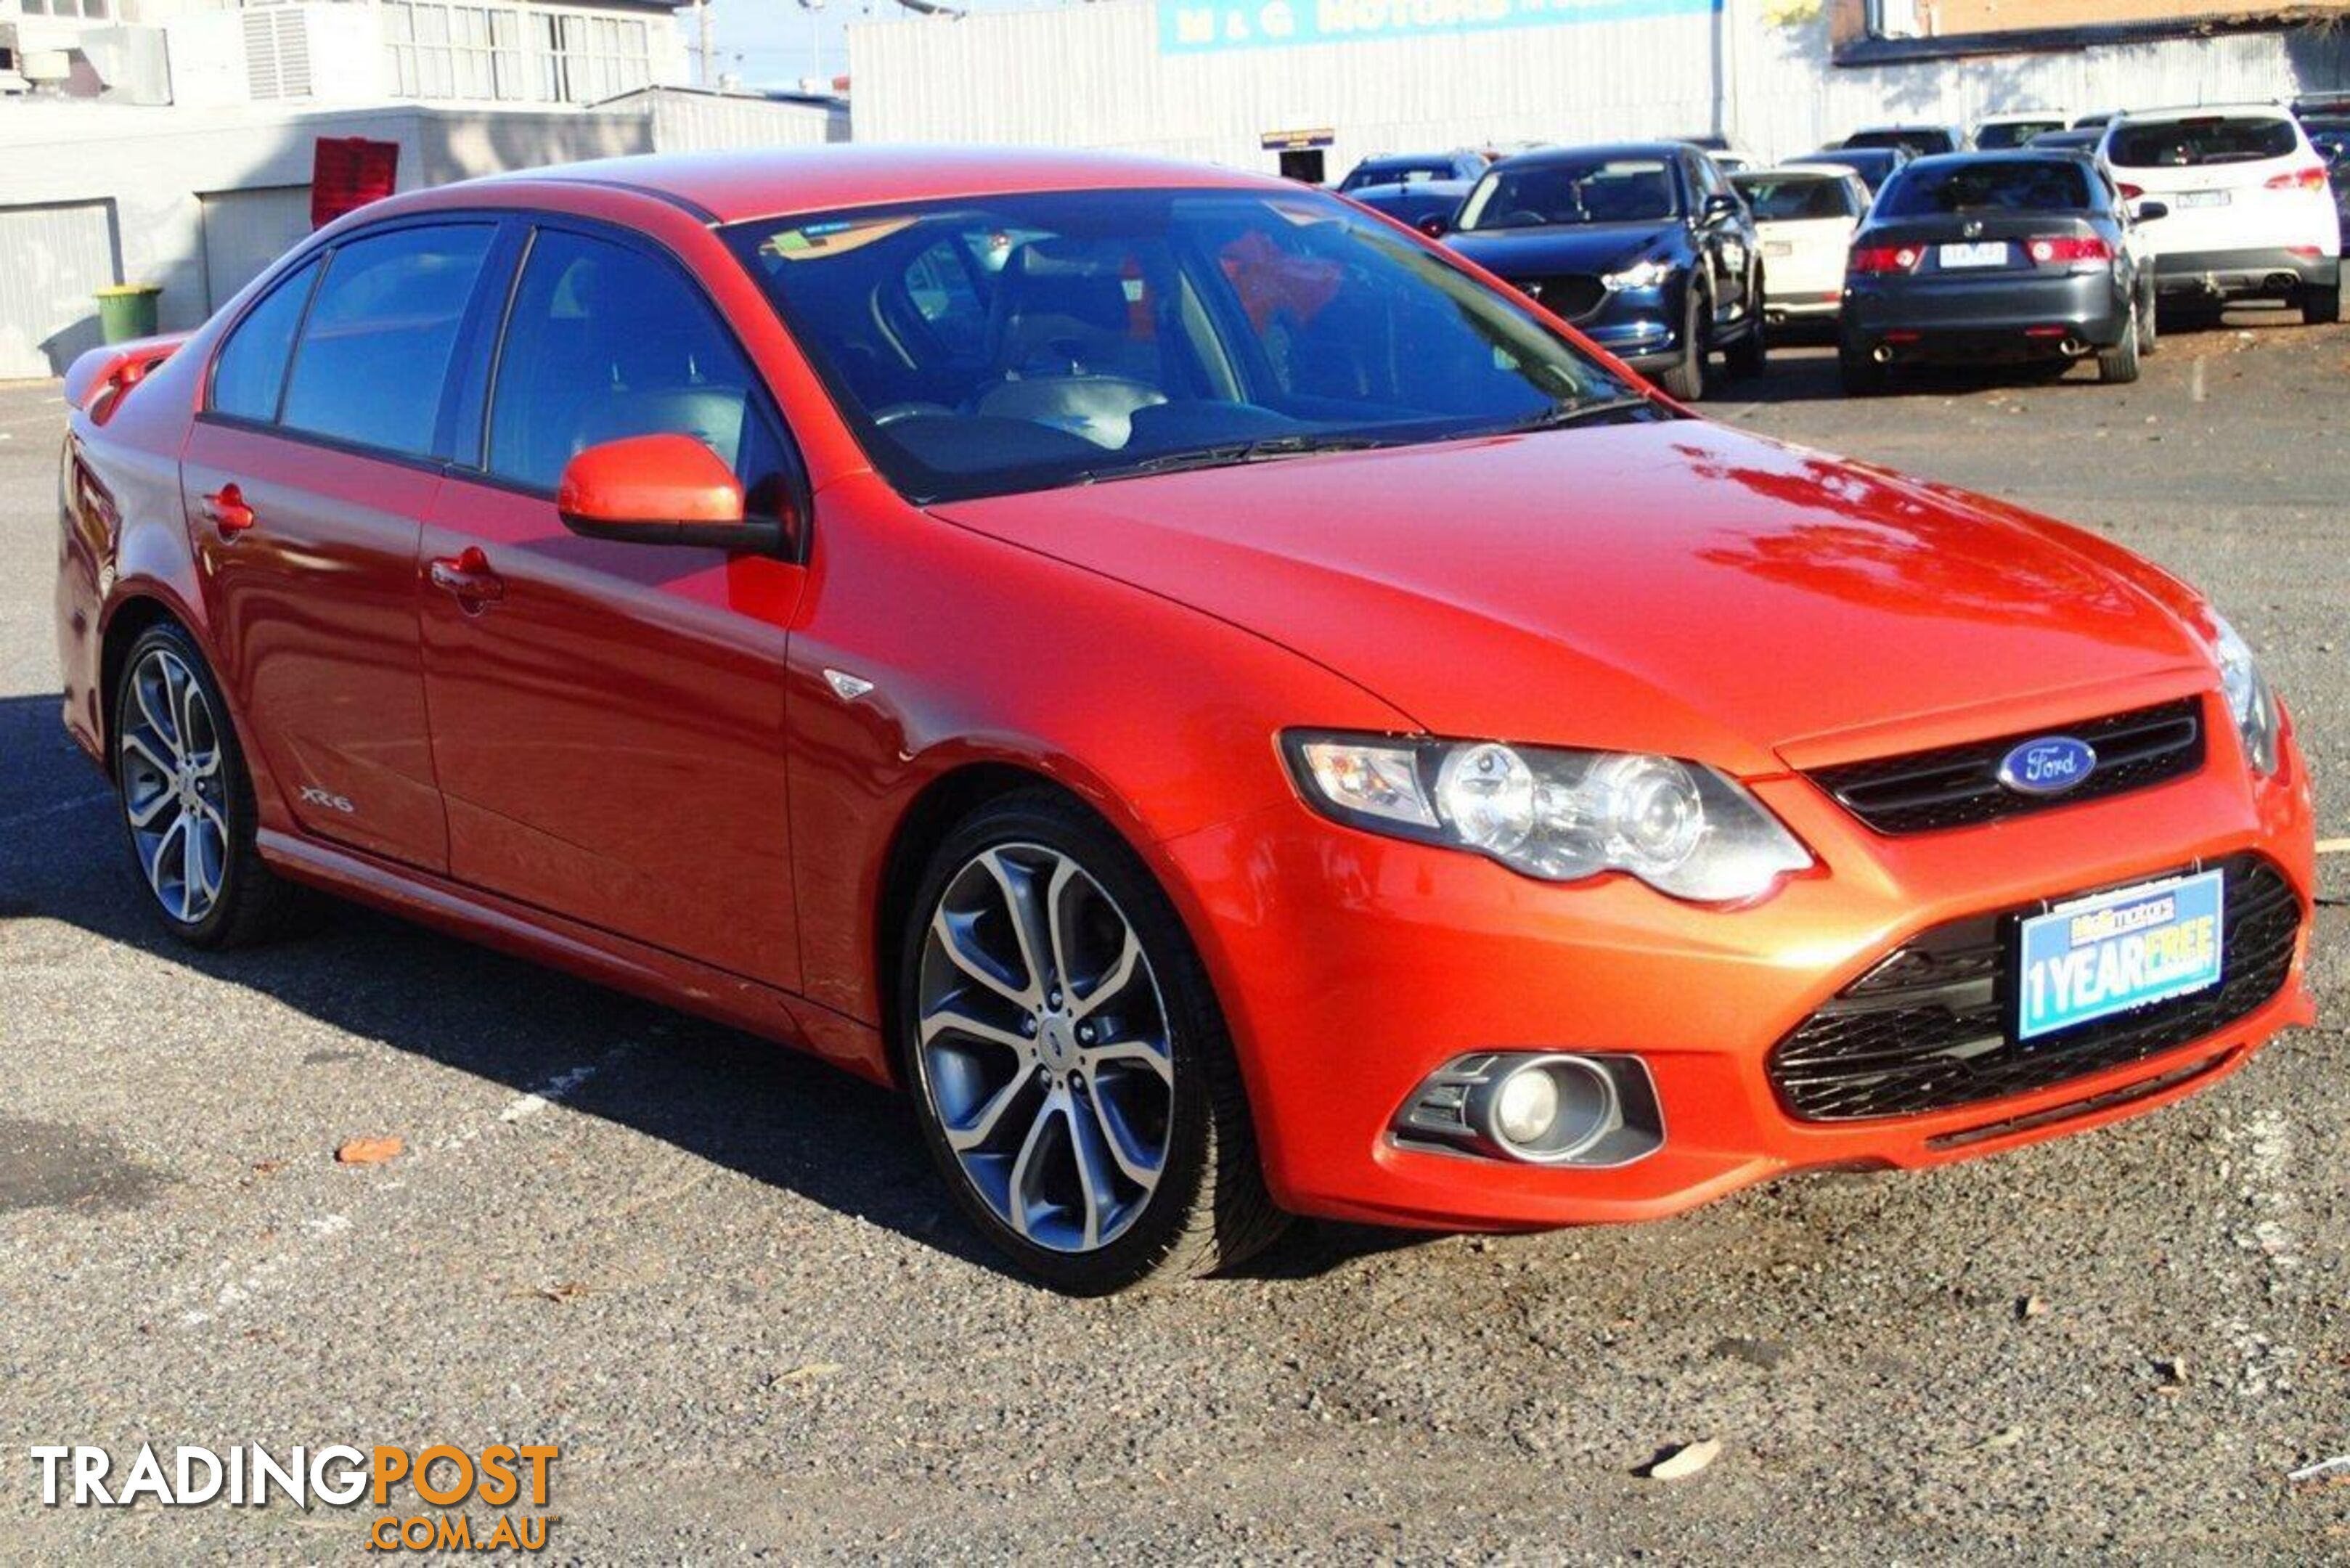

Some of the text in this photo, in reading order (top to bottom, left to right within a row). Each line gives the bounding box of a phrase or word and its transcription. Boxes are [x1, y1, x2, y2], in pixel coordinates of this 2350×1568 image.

[1176, 8, 1214, 43] M
[1260, 0, 1294, 37] G
[2026, 746, 2077, 780] Ford
[300, 785, 354, 812] XR6
[2029, 960, 2046, 1021] 1
[2047, 934, 2145, 1013] YEAR
[2144, 915, 2213, 971] FREE
